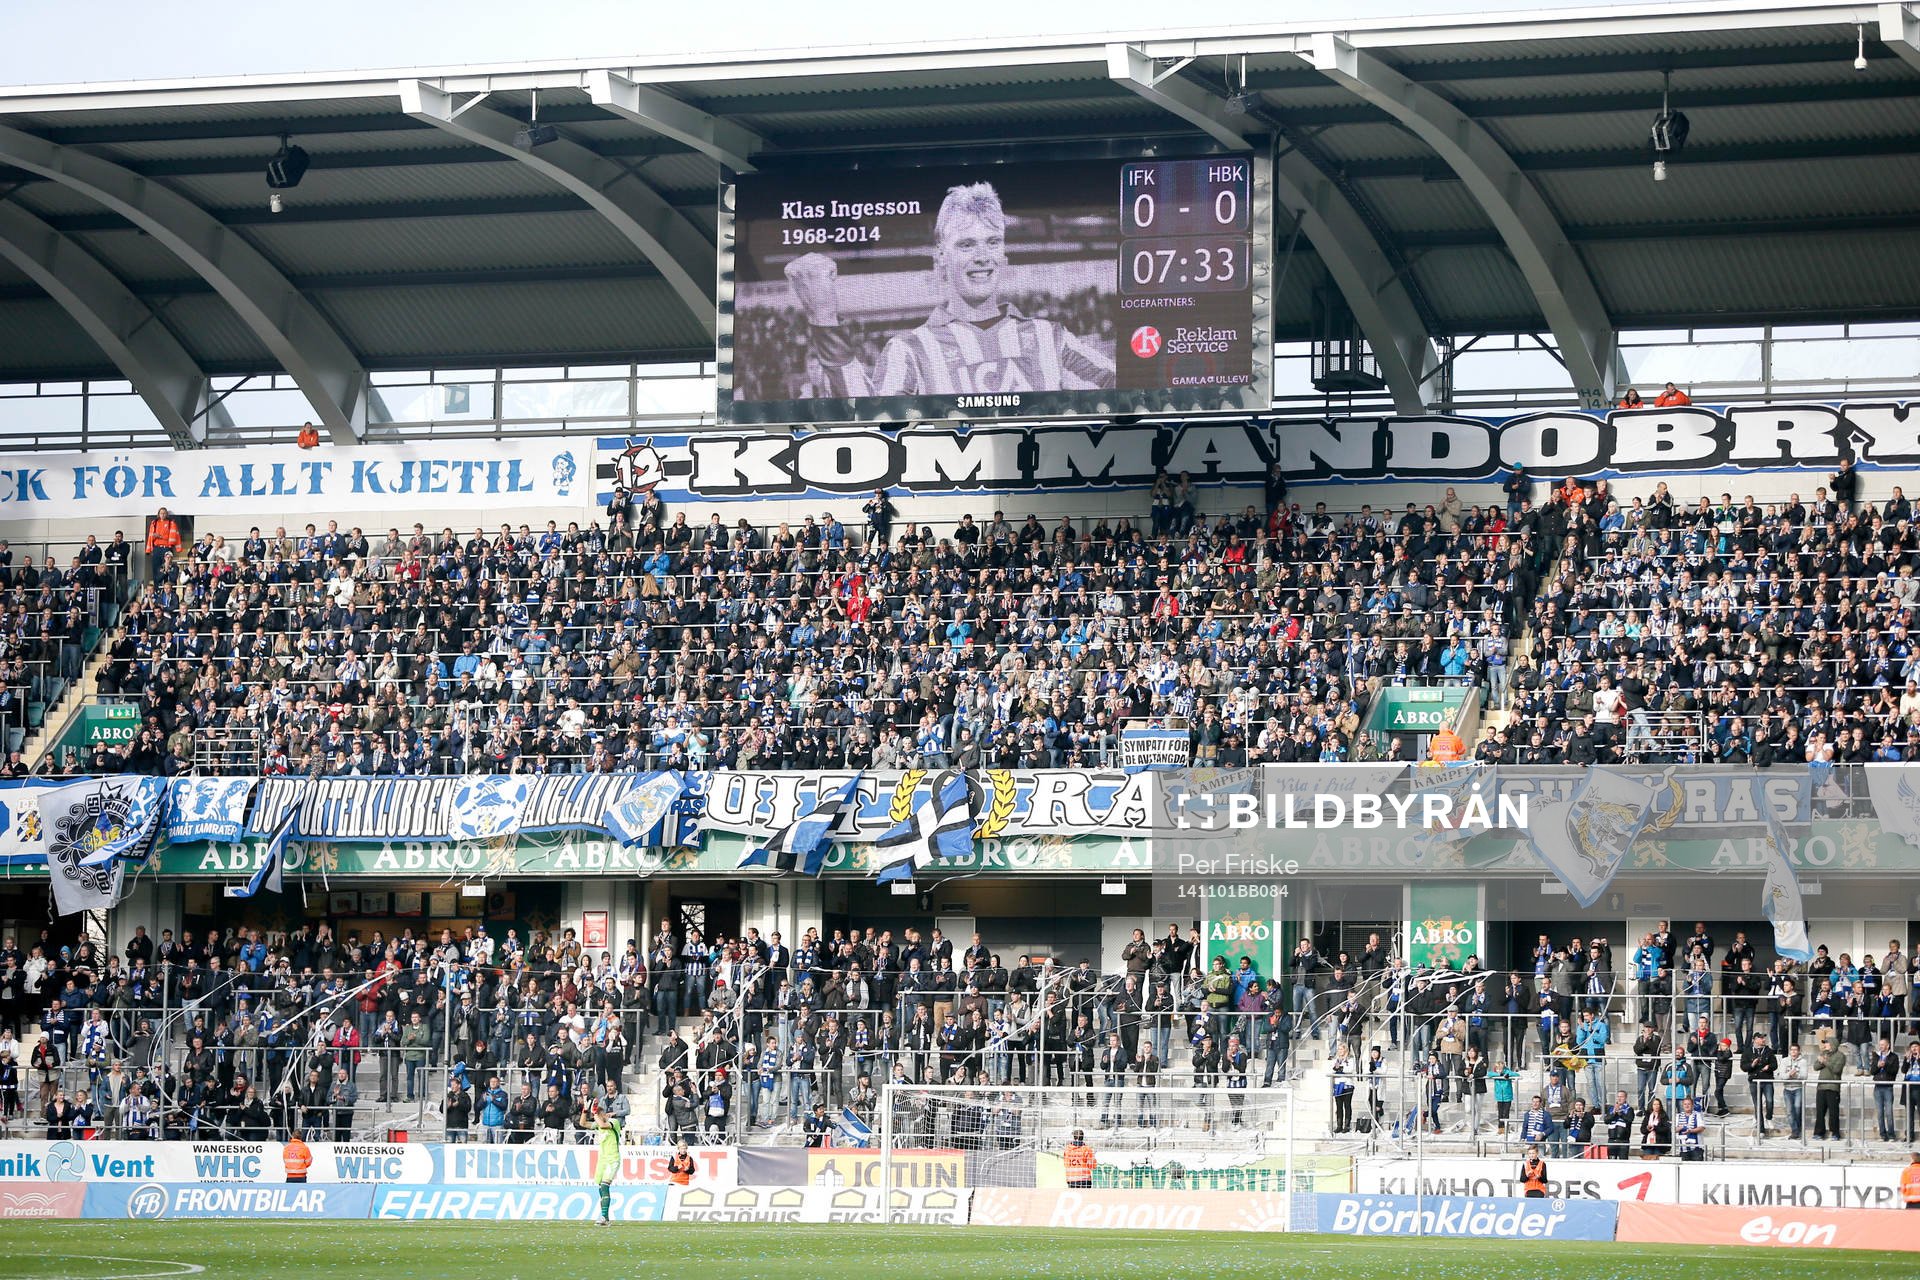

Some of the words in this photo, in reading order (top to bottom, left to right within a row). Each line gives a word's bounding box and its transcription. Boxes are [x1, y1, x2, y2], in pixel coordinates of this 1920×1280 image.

[1129, 169, 1155, 186] IFK
[1208, 165, 1244, 183] HBK
[782, 201, 825, 219] Klas
[830, 200, 921, 220] Ingesson
[1134, 193, 1155, 228] 0
[1215, 190, 1237, 224] 0
[782, 226, 881, 245] 1968-2014
[1133, 247, 1235, 285] 07:33
[1121, 297, 1196, 309] LOGEPARTNERS:
[1176, 326, 1237, 342] Reklam
[1167, 339, 1229, 354] Service
[1172, 376, 1207, 385] GAMLA
[1215, 375, 1249, 384] ULLEVI
[957, 395, 1021, 408] SAMSUNG
[72, 456, 177, 499] FÖR
[198, 462, 333, 497] ALLT
[351, 459, 535, 494] KJETIL
[617, 446, 662, 488] 12
[1394, 710, 1443, 724] ÅBRO
[90, 726, 134, 740] ÅBRO
[1124, 740, 1167, 752] SYMPATI
[1168, 738, 1190, 751] FÖR
[1125, 755, 1137, 765] DE
[251, 777, 458, 838] SUPPORTERKLUBBEN
[1210, 923, 1270, 941] ÅBRO
[1411, 926, 1473, 945] ÅBRO
[193, 1144, 263, 1154] WANGESKOG
[333, 1146, 405, 1155] WANGESKOG
[0, 1153, 41, 1177] nik
[91, 1154, 155, 1178] Vent
[194, 1155, 262, 1178] WHC
[335, 1156, 403, 1179] WHC
[455, 1149, 581, 1179] FRIGGA
[852, 1160, 958, 1188] JOTUN
[1500, 1179, 1601, 1200] TRES
[1702, 1183, 1822, 1208] KUMHO
[174, 1188, 327, 1213] FRONTBILAR
[378, 1190, 656, 1221] EHRENBORG
[1053, 1191, 1205, 1230] Renova
